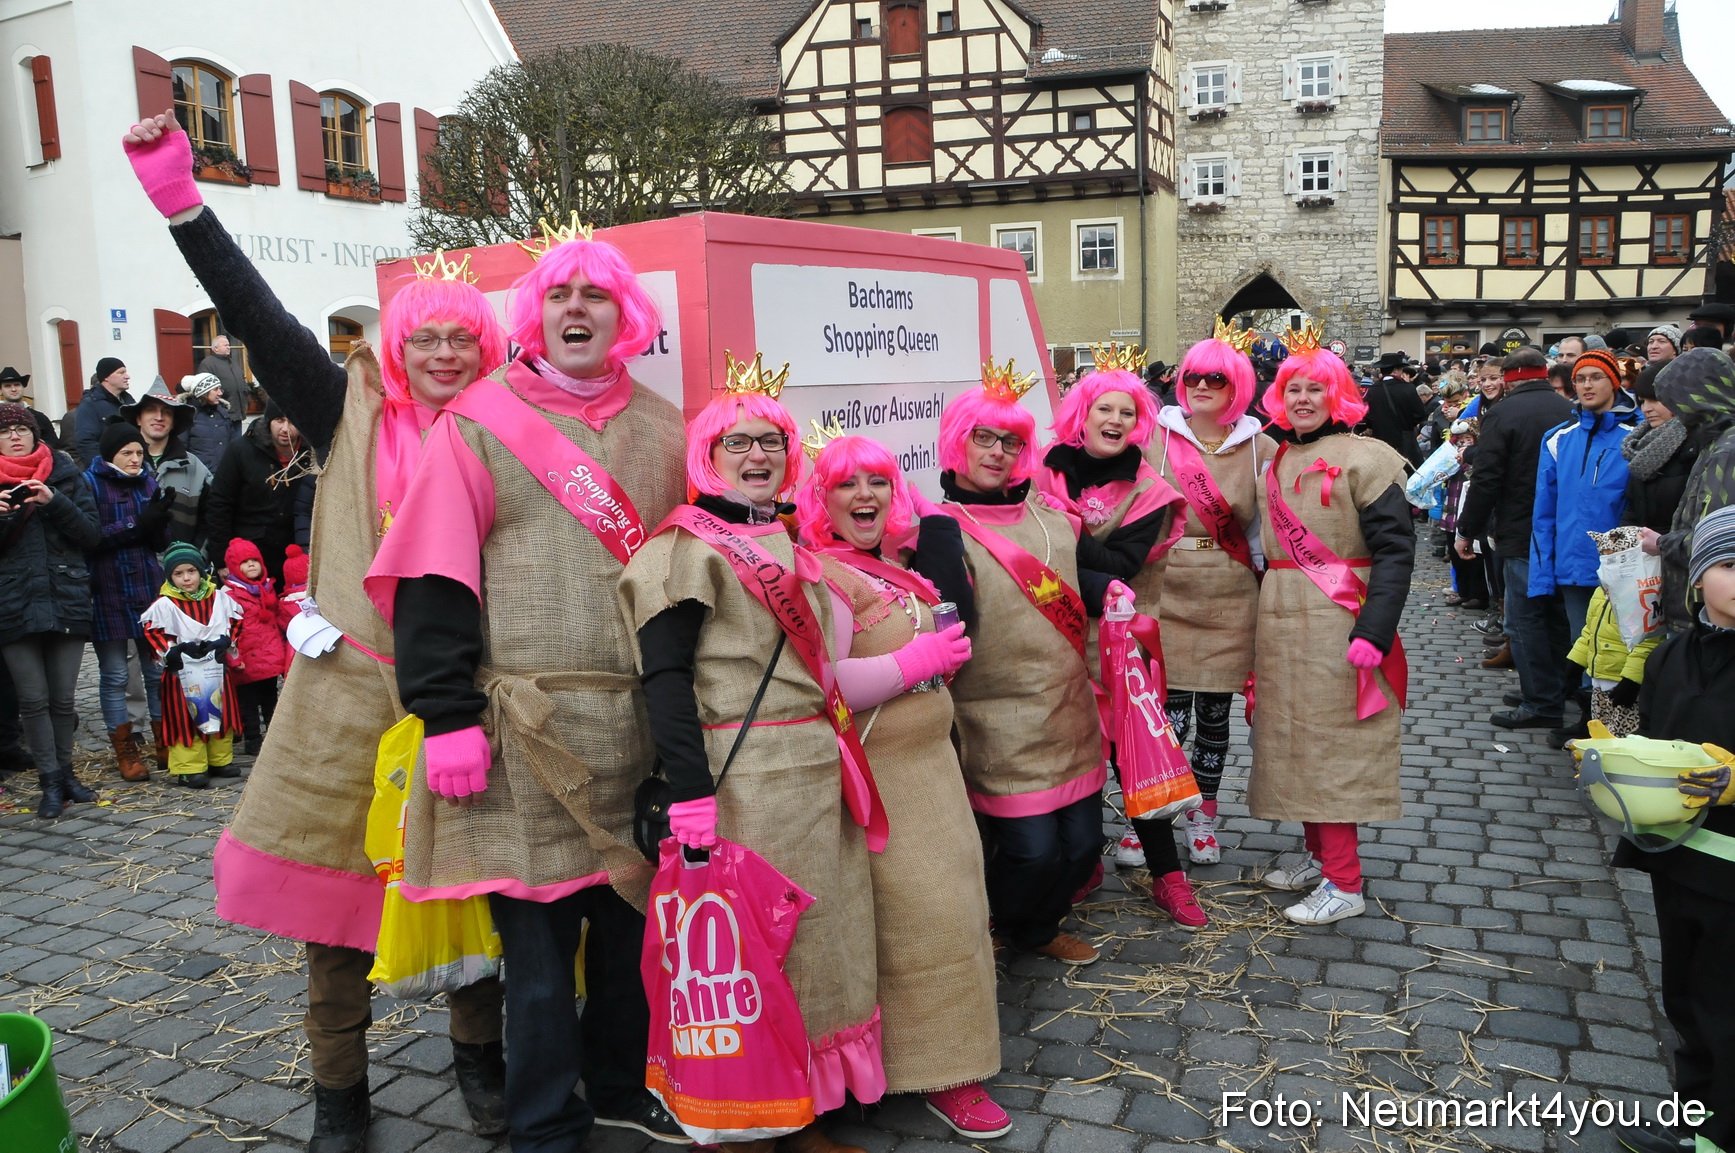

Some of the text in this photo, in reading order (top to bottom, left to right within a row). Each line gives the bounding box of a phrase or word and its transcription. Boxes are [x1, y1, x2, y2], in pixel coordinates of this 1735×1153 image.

[234, 233, 315, 263] URIST
[848, 281, 914, 310] Bachams
[823, 323, 939, 358] Shopping Queen
[822, 392, 944, 430] weiß vor Auswahl
[570, 464, 631, 530] Shopping
[1193, 472, 1225, 517] Shopping
[1286, 527, 1328, 572] Queen
[692, 512, 808, 634] Shopping Queen
[671, 970, 761, 1027] ahre
[674, 1027, 741, 1057] NKD
